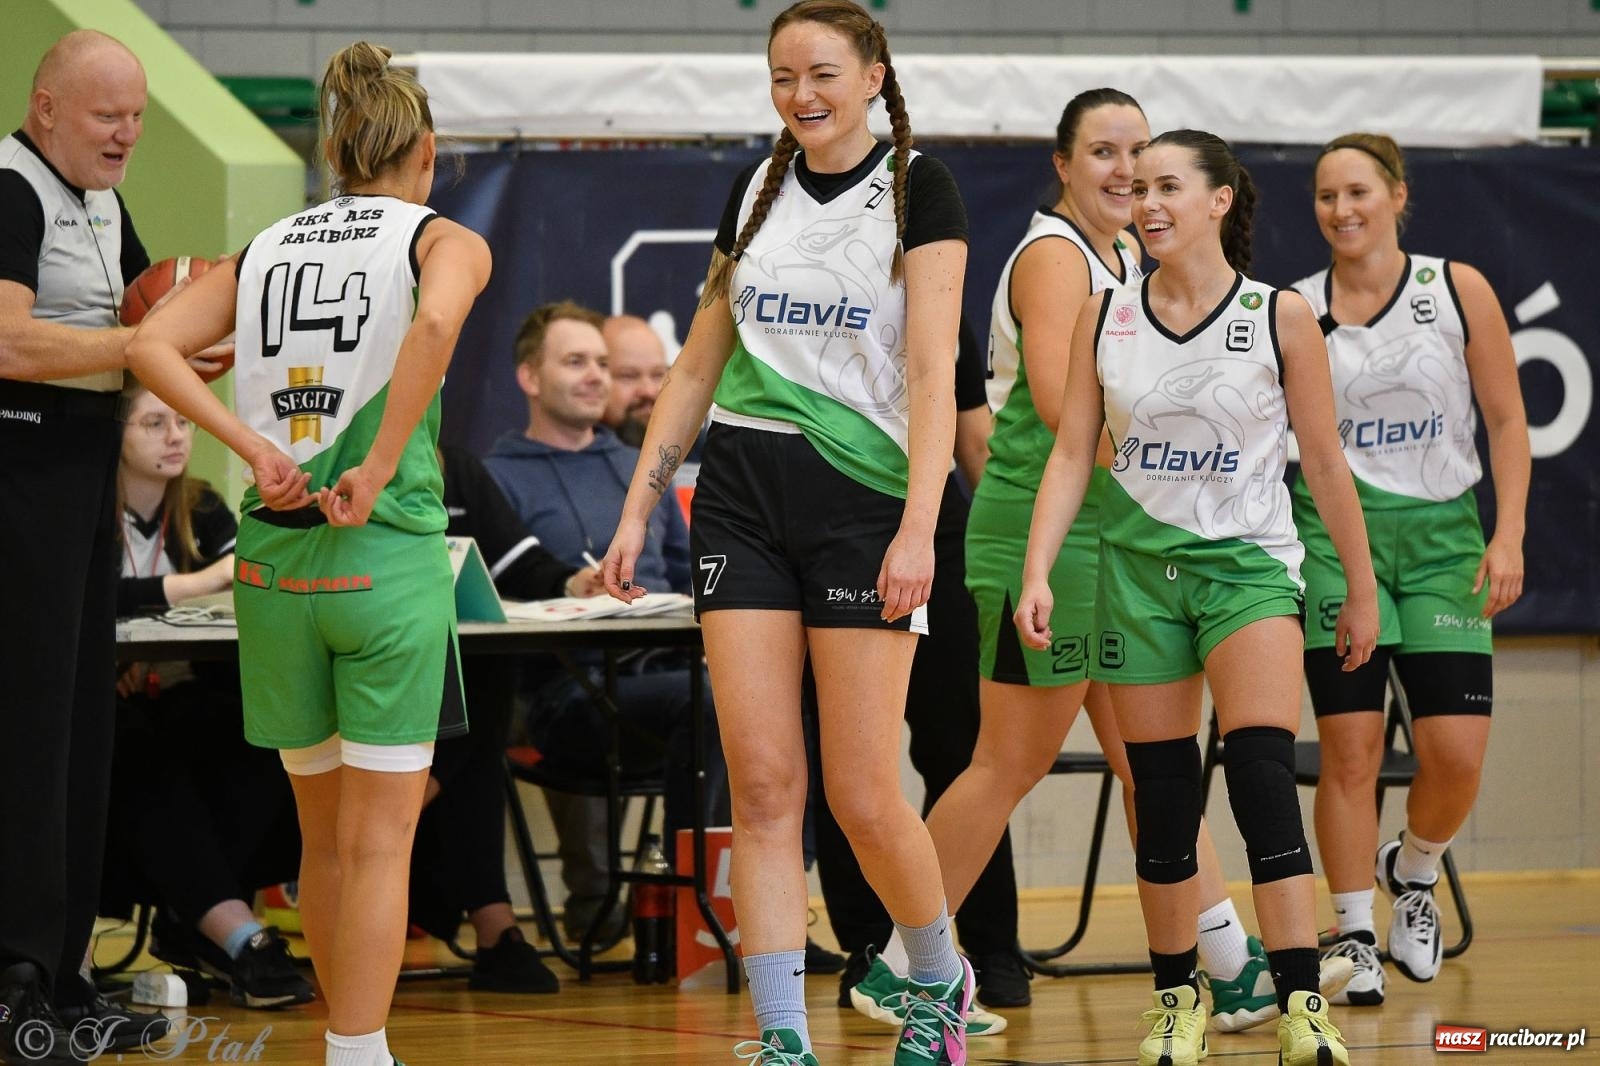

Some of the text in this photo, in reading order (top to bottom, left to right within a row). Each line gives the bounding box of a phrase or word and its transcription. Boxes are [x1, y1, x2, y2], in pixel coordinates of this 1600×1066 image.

[864, 177, 894, 210] 7
[291, 209, 384, 227] RKK AZS
[279, 225, 380, 245] RACIBÓRZ
[261, 262, 370, 357] 14
[756, 293, 872, 331] Clavis
[1410, 294, 1437, 324] 3
[764, 327, 859, 340] DORABIANIE KLUCZY
[1225, 319, 1256, 352] 8
[276, 391, 337, 414] SEGIT
[1140, 441, 1240, 473] Clavis
[1146, 474, 1235, 484] DORABIANIE KLUCZY
[700, 554, 727, 595] 7
[1099, 631, 1126, 669] 8
